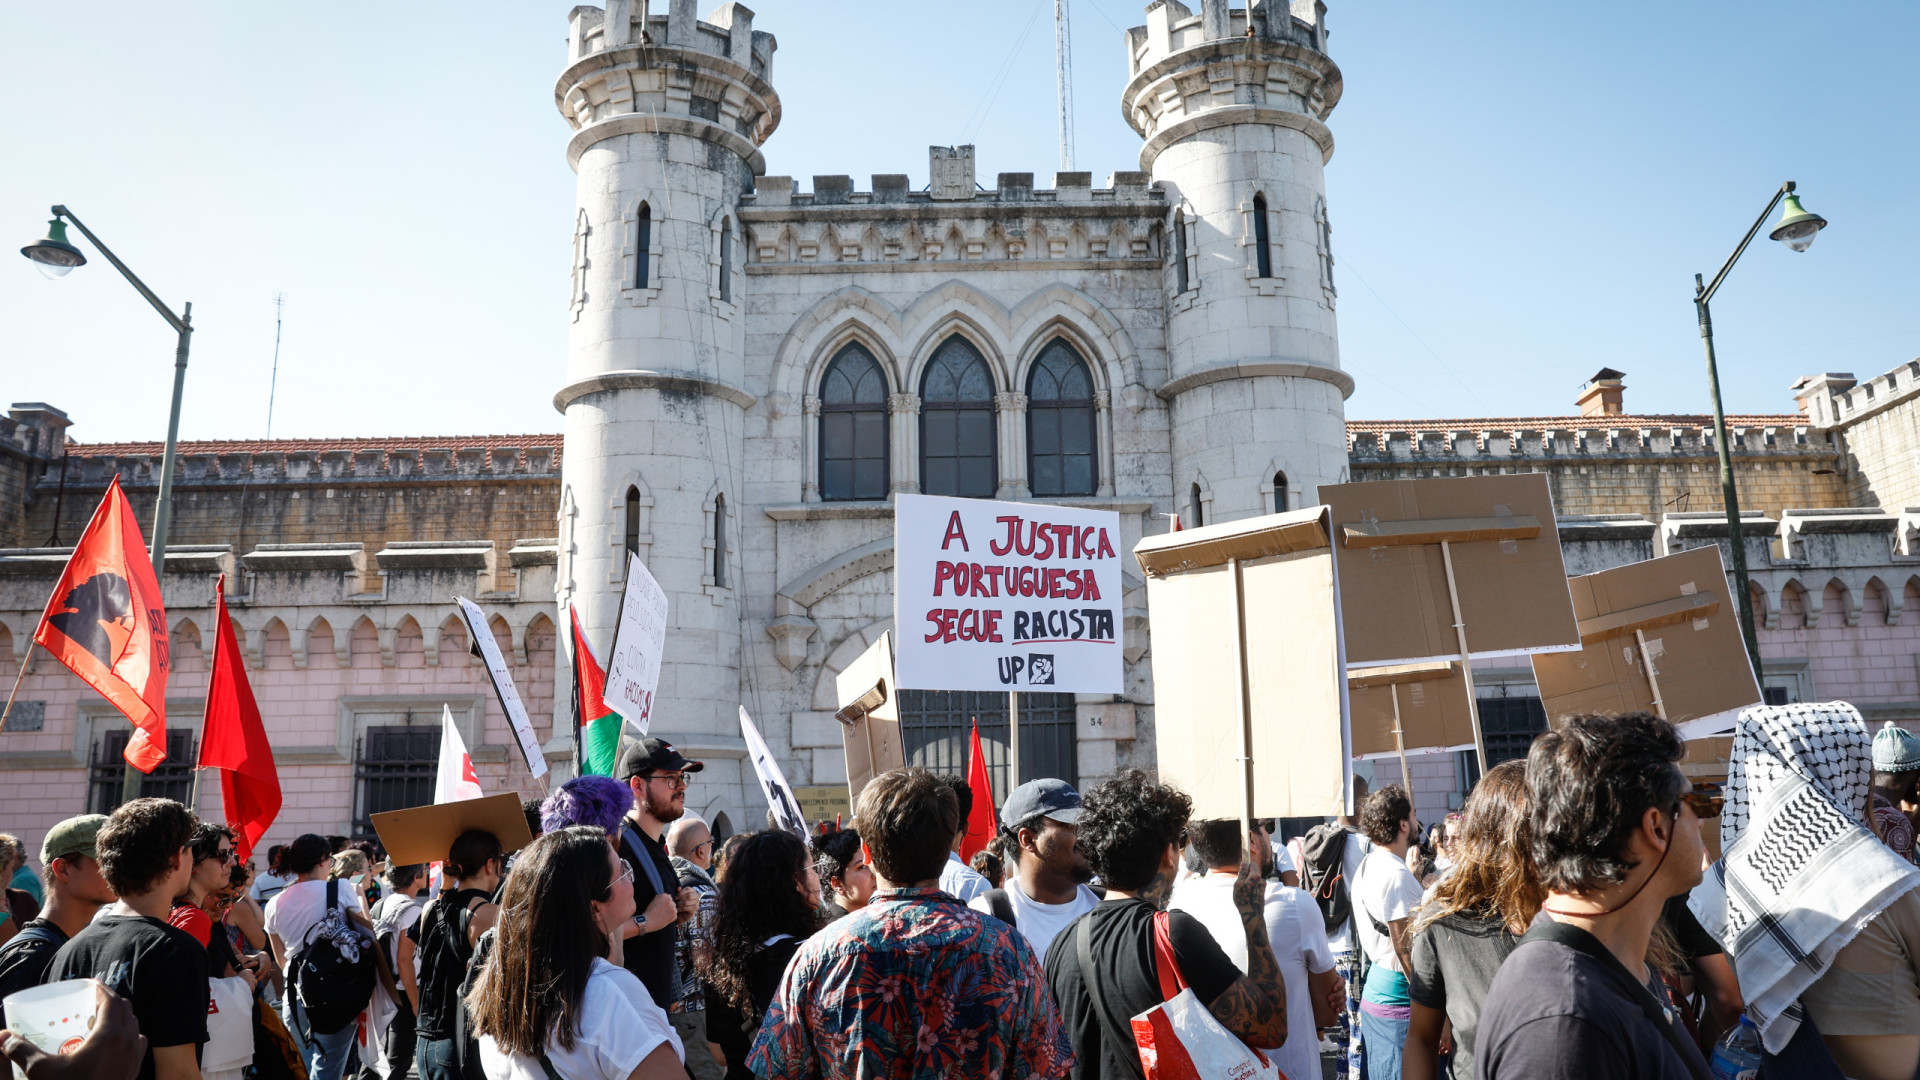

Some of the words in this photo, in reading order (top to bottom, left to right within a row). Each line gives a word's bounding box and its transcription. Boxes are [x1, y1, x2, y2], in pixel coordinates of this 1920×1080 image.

[941, 510, 969, 552] A
[990, 516, 1116, 560] JUSTIÇA
[933, 561, 1101, 601] PORTUGUESA
[924, 609, 1003, 643] SEGUE
[1013, 609, 1115, 641] RACISTA
[998, 656, 1024, 685] UP
[624, 679, 645, 710] RACISMO
[1090, 717, 1102, 727] 54
[830, 798, 848, 806] PRISIONAL
